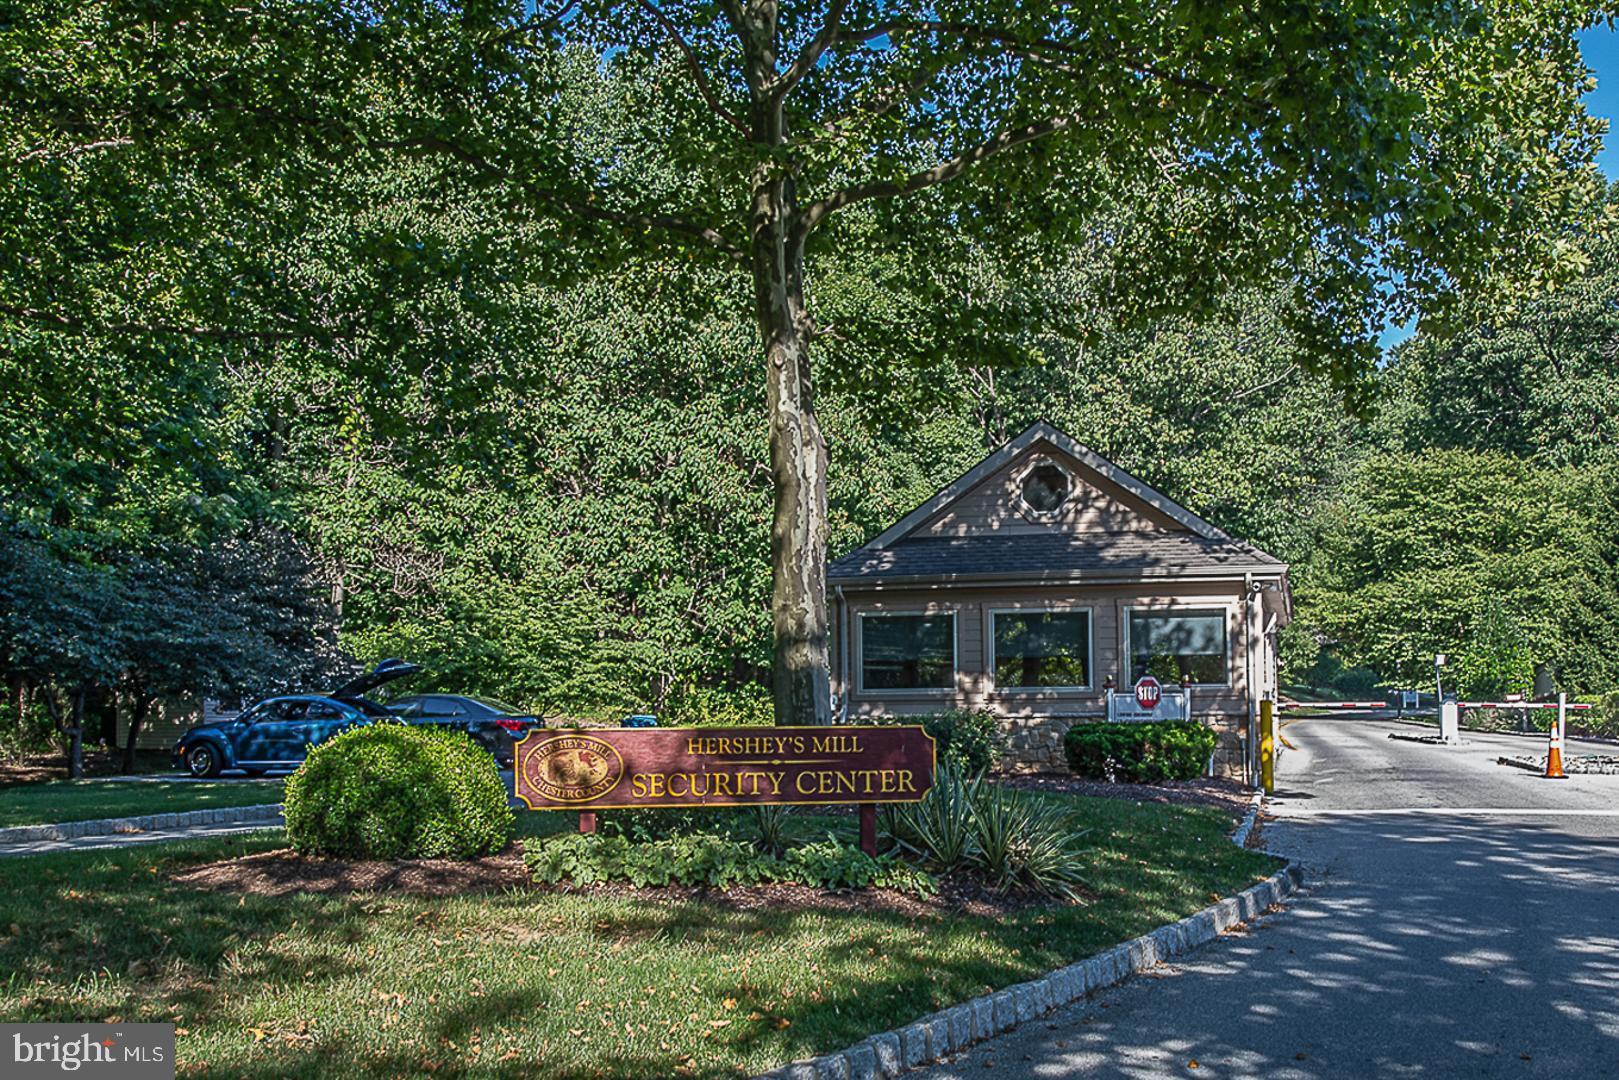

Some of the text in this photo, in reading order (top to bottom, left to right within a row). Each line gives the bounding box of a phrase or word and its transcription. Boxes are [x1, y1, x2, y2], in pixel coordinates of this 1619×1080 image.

[1137, 686, 1158, 700] STOP
[587, 742, 610, 760] MILL
[688, 736, 864, 755] HERSHEY'S MILL
[532, 775, 616, 798] CHESTER COUNTY
[631, 769, 917, 798] SECURITY CENTER
